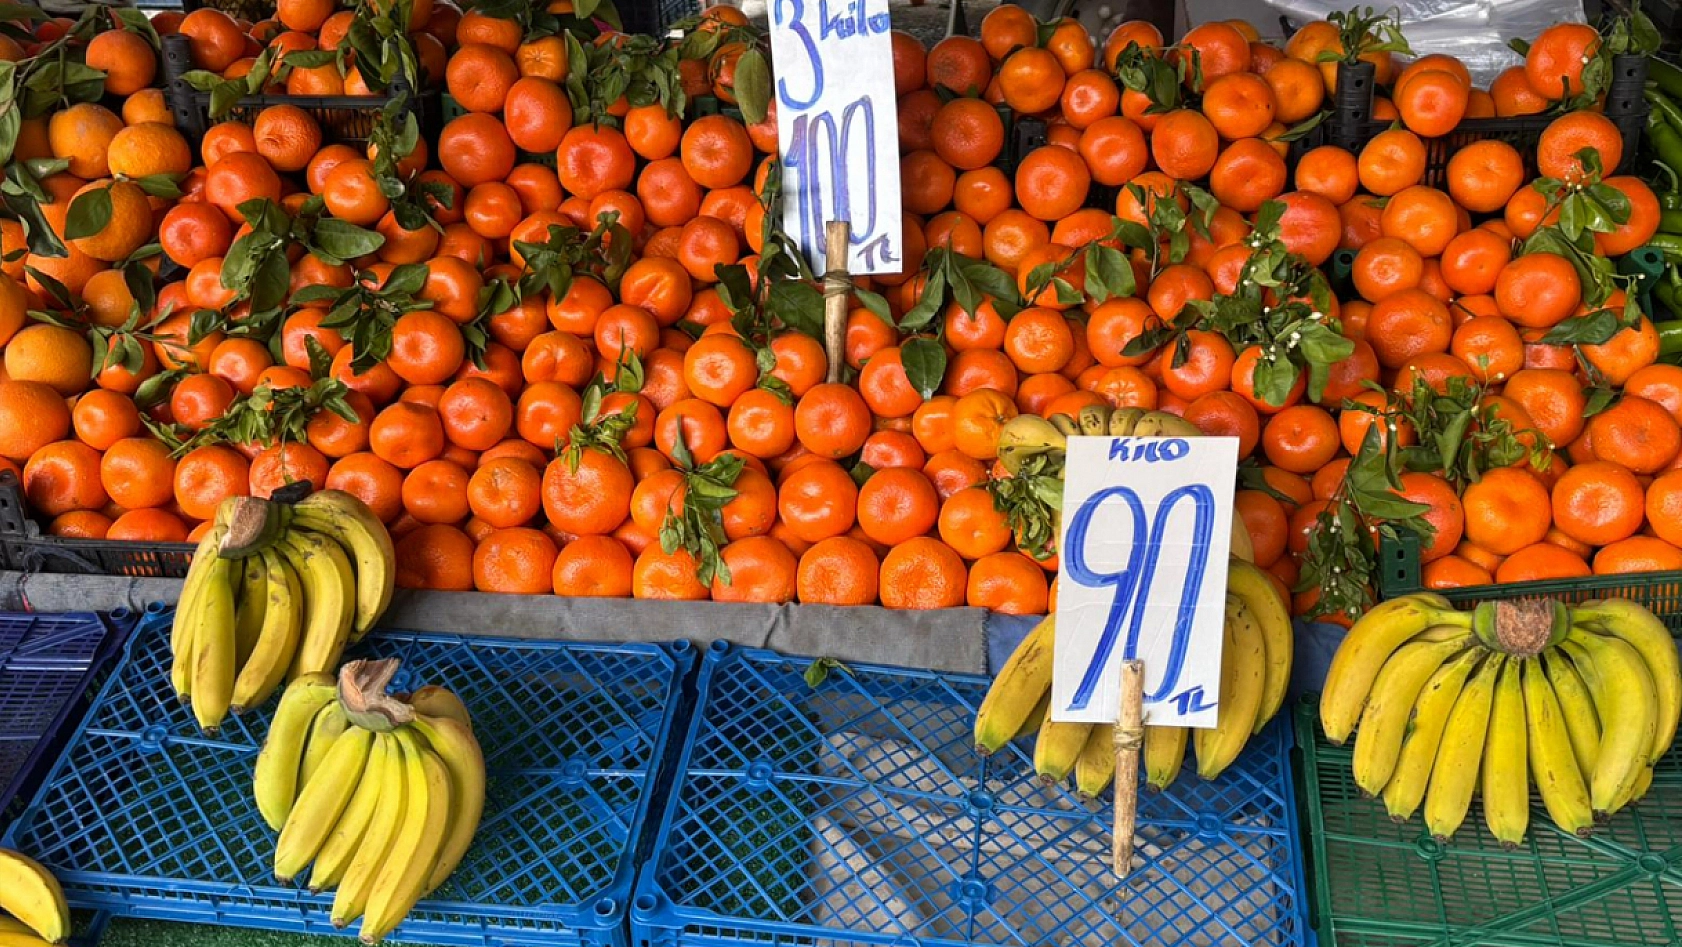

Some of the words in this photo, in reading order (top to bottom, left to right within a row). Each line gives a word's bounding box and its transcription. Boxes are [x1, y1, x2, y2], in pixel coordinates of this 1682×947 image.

[774, 0, 824, 110] 3
[784, 95, 876, 262] 100
[856, 233, 900, 271] TL
[1065, 484, 1215, 711] 90
[1169, 685, 1217, 715] TL
